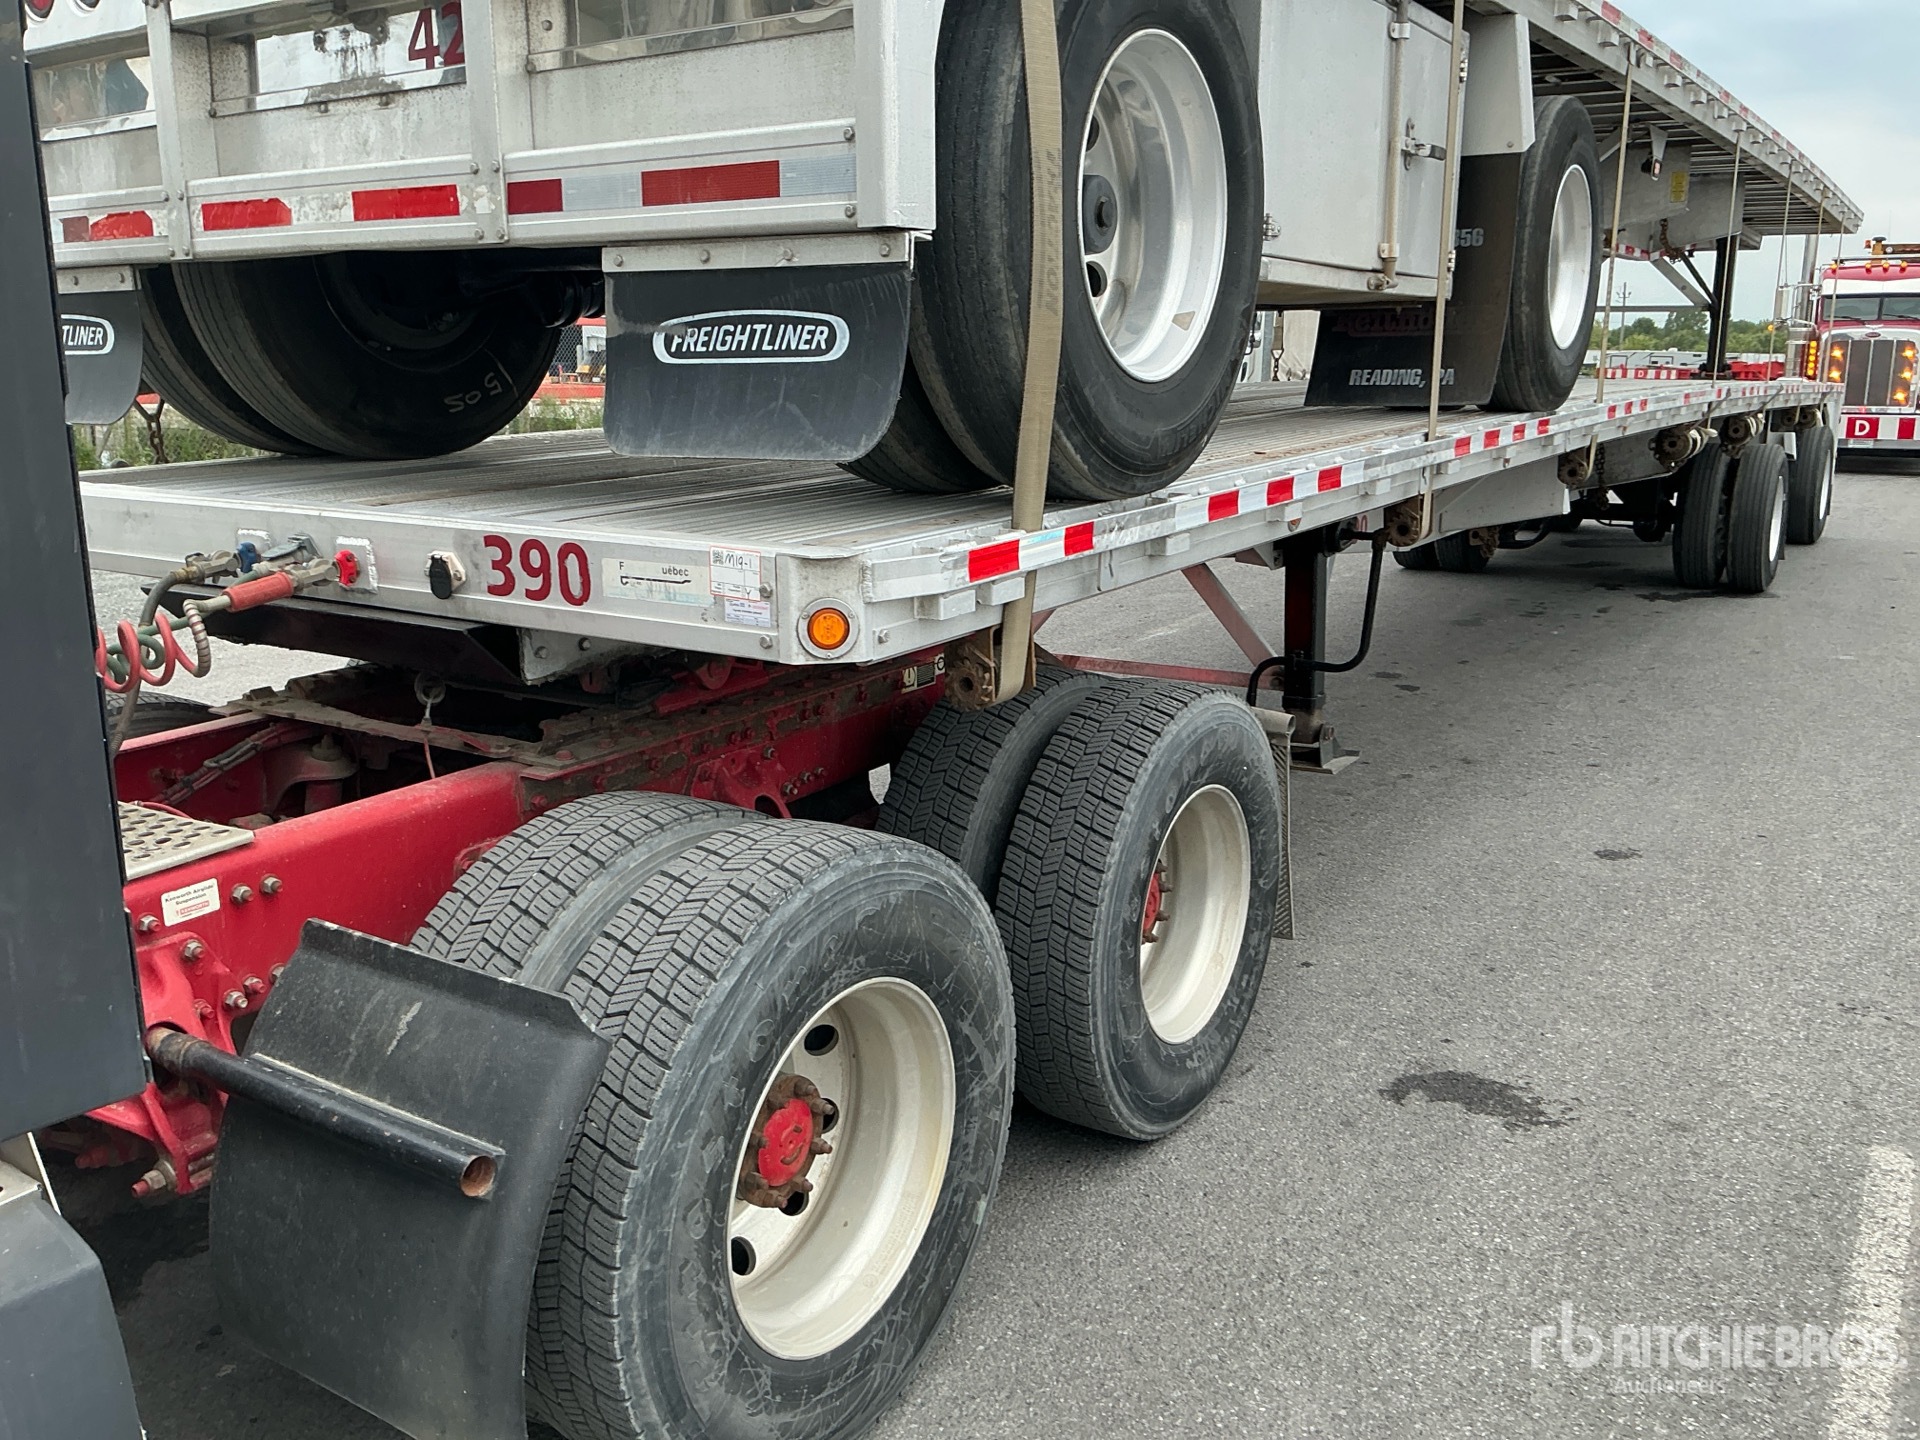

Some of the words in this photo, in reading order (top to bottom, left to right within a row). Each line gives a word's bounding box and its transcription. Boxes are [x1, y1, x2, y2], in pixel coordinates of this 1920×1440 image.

[62, 325, 104, 346] TLINER
[670, 323, 830, 353] FREIGHTLINER
[1348, 368, 1426, 388] READING,
[1854, 419, 1870, 436] D
[483, 534, 591, 606] 390
